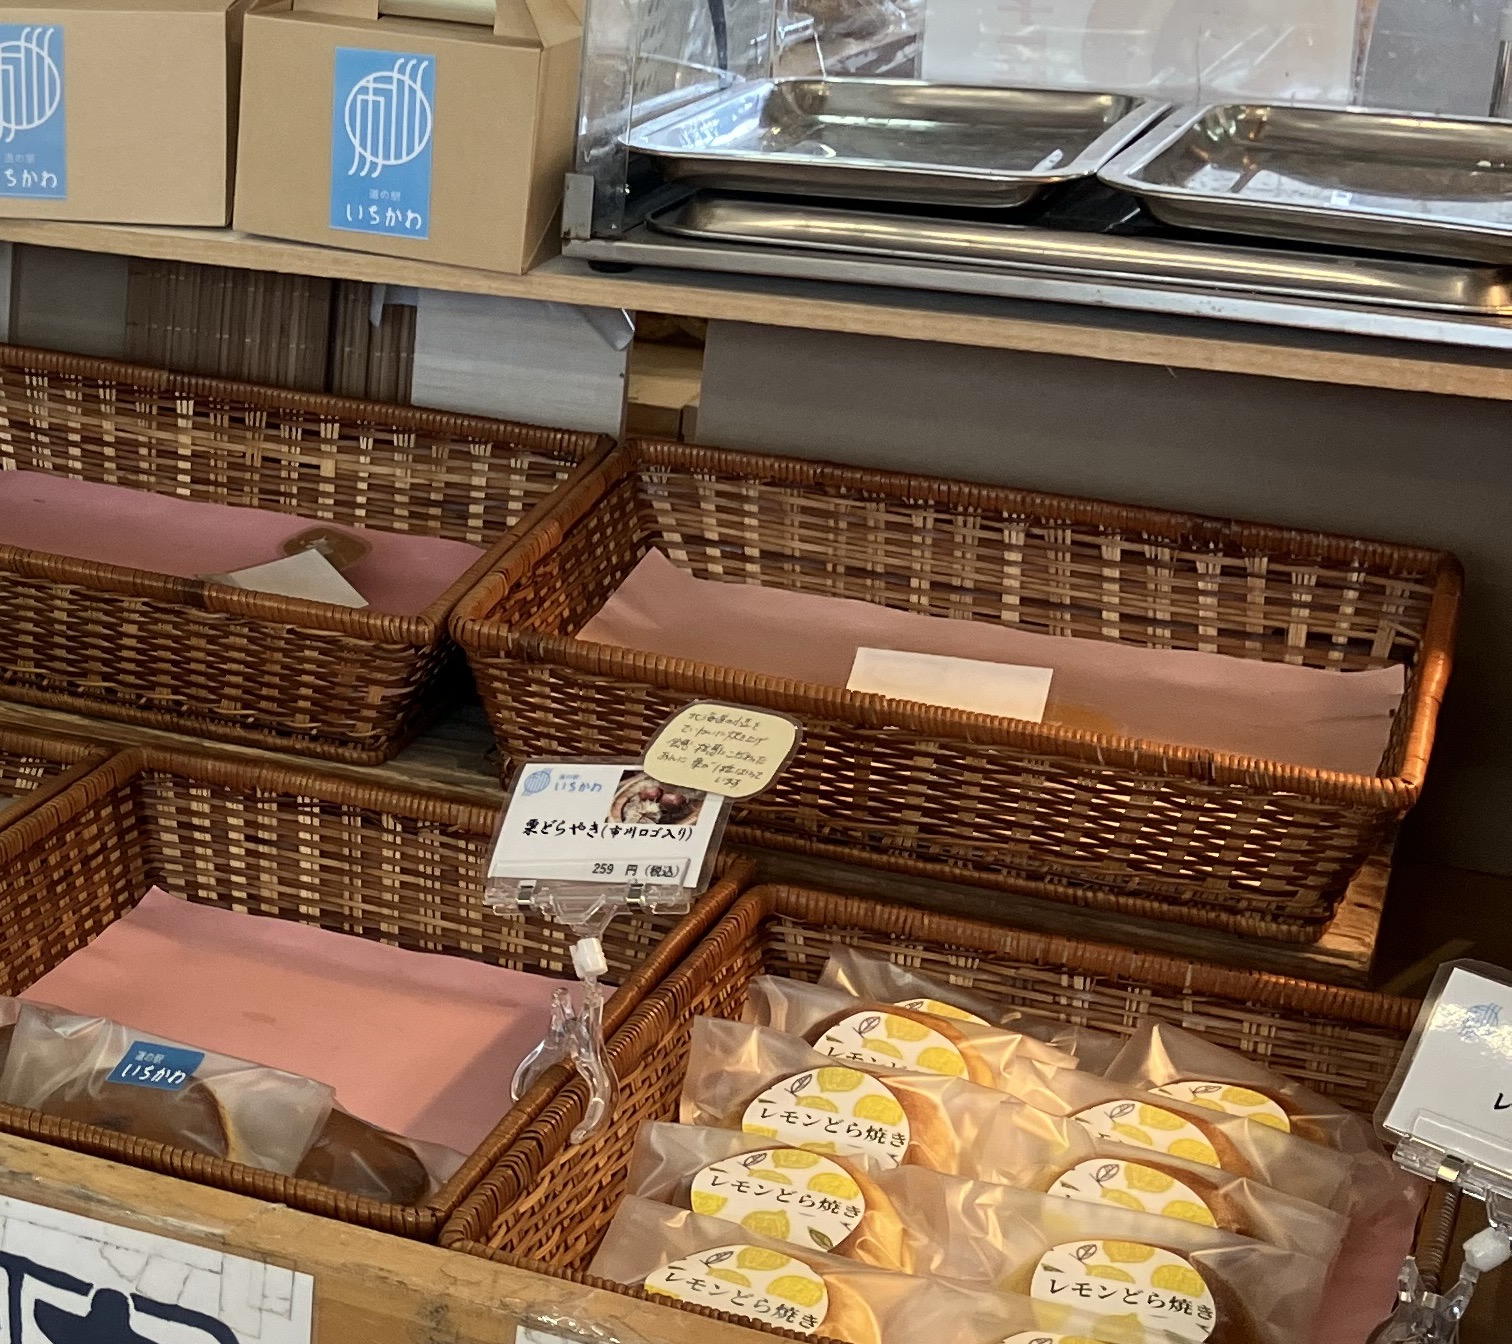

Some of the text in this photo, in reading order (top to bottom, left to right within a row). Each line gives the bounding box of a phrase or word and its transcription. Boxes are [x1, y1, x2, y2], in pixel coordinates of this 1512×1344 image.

[346, 202, 422, 230] いちかわ
[522, 817, 694, 841] 栗どらやき(市川ロゴ入り)
[592, 862, 681, 878] 259 円 (税込)
[121, 1063, 186, 1085] いちかわ
[759, 1106, 908, 1149] レモンどら焼き
[710, 1174, 862, 1218] レモンどら焼き
[664, 1271, 819, 1330] レモンどら焼き
[1049, 1278, 1214, 1321] レモンどら焼き
